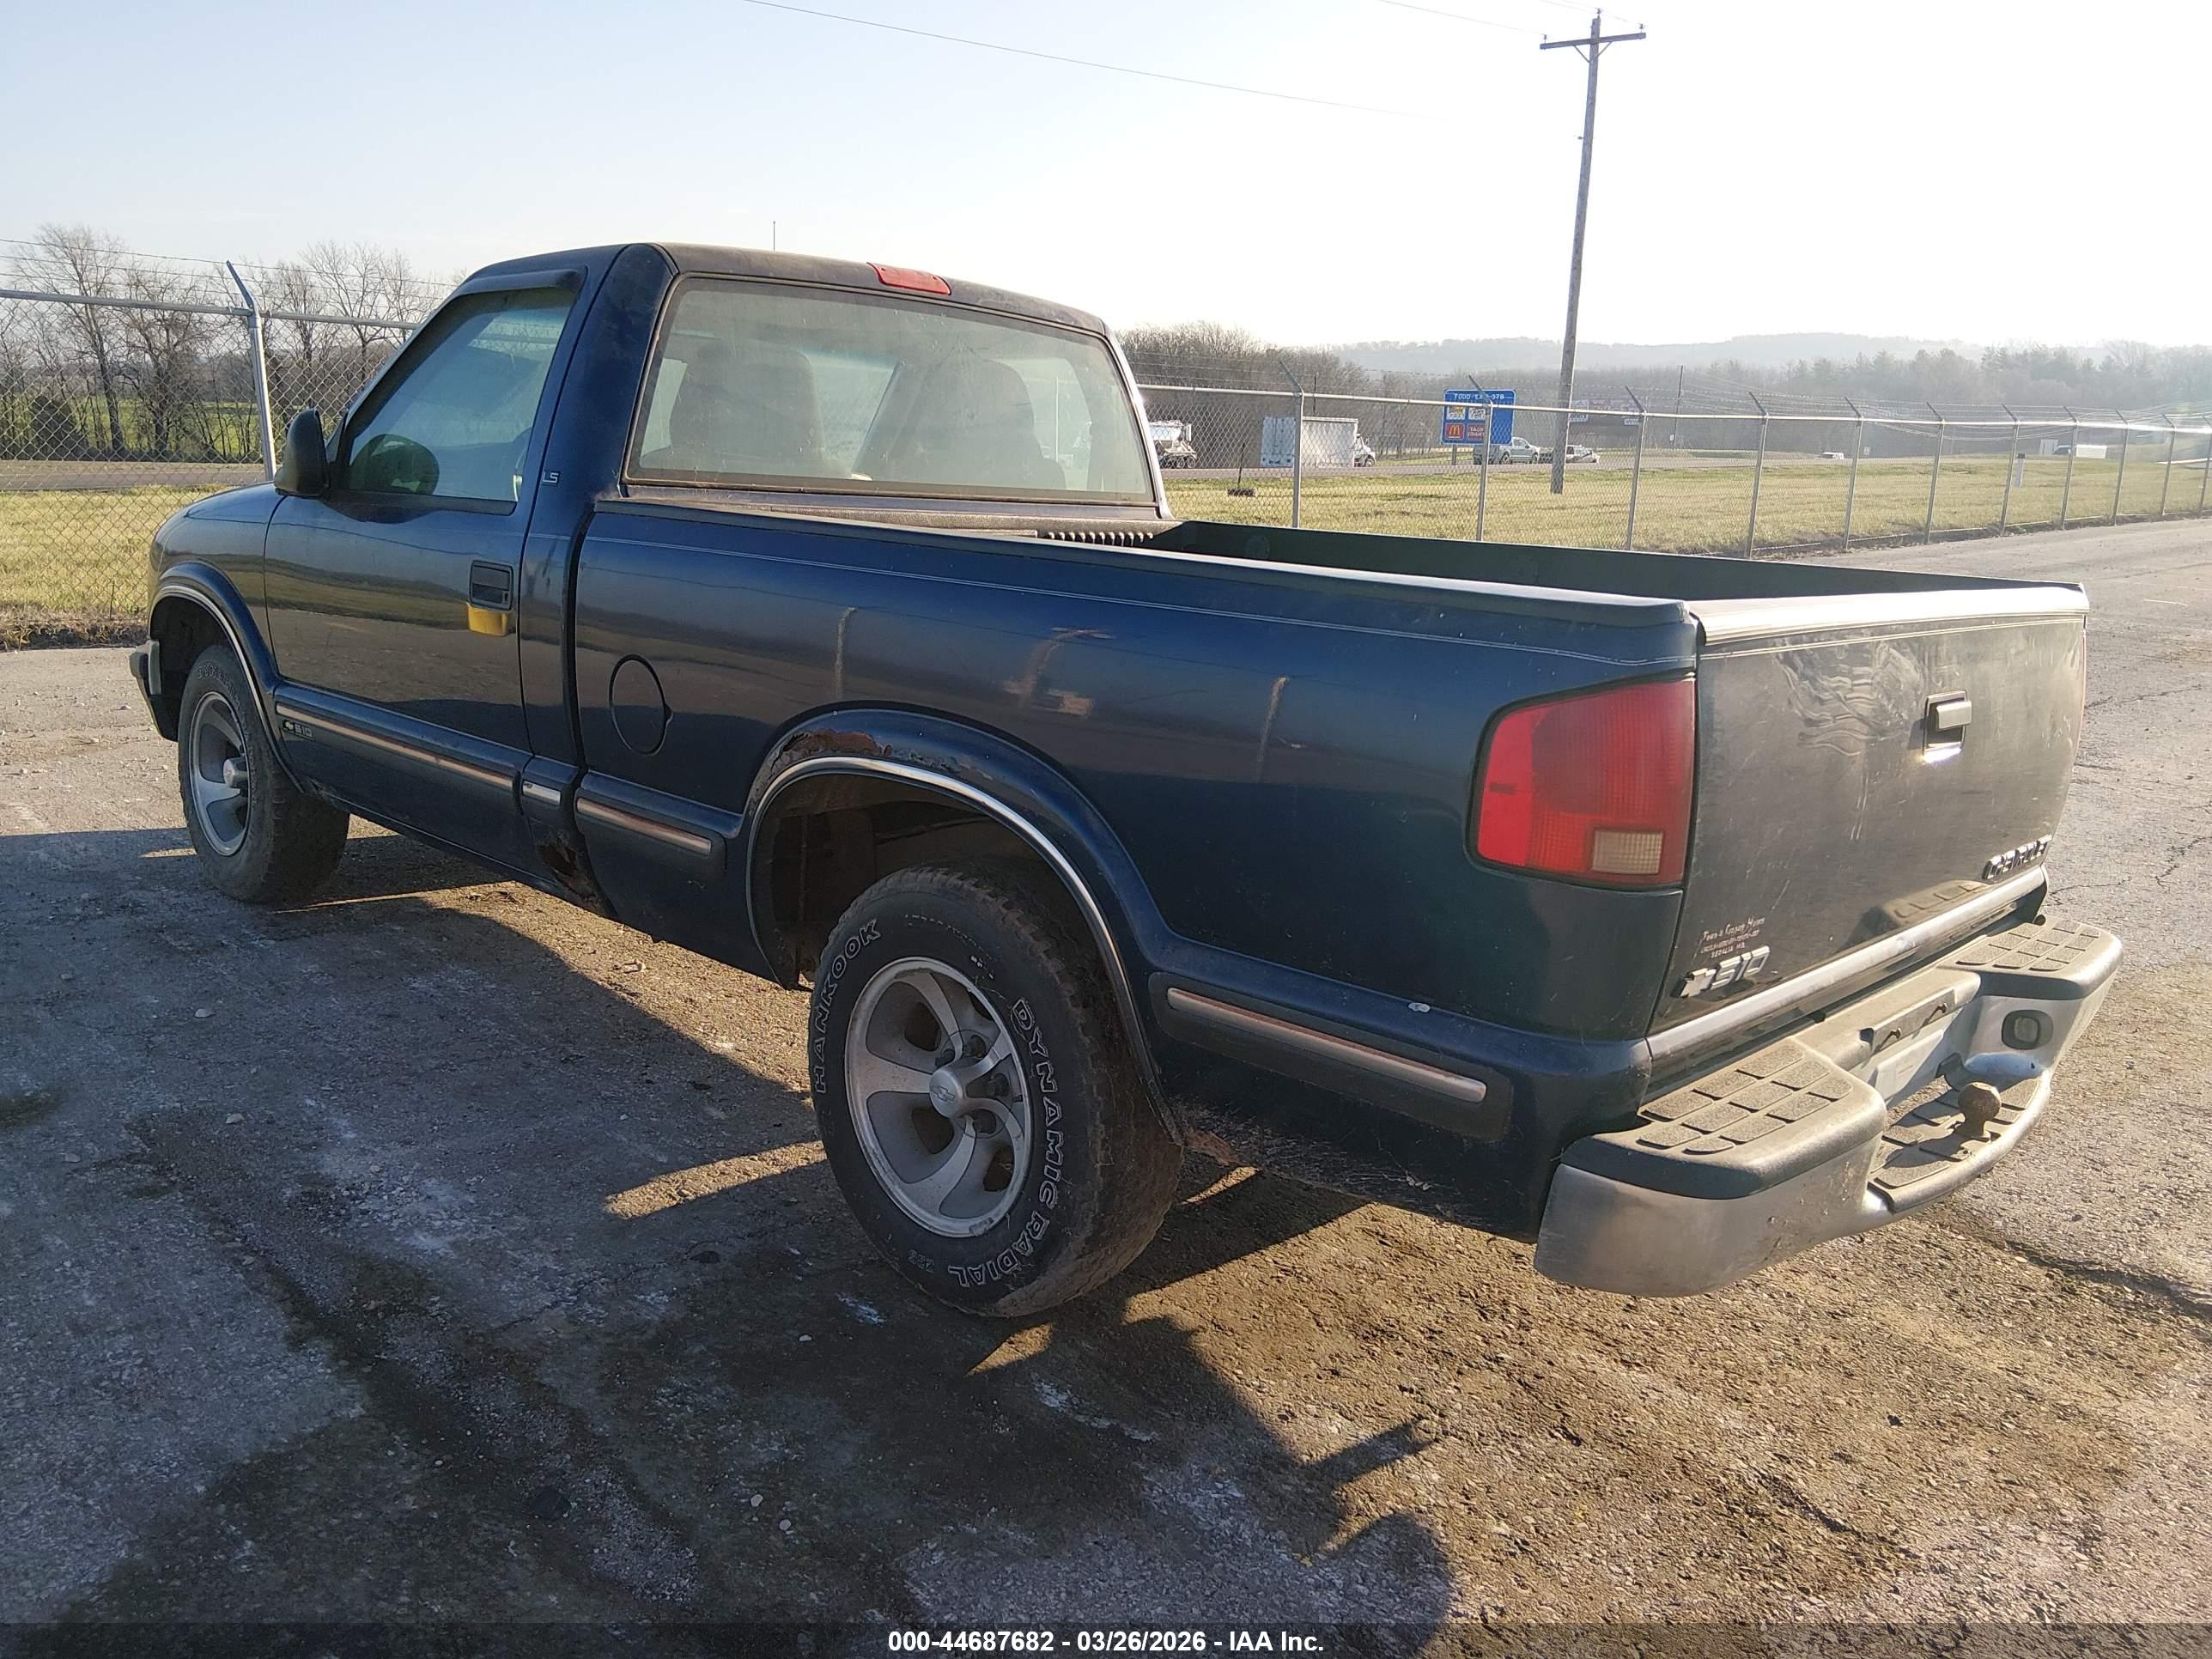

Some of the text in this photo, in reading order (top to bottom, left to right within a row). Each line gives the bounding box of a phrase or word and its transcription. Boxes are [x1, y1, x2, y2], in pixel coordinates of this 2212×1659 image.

[542, 471, 559, 483] LS
[810, 918, 882, 1095] HANKOOK
[1710, 945, 1771, 990] S10
[947, 996, 1065, 1288] DYNAMIC RADIAL
